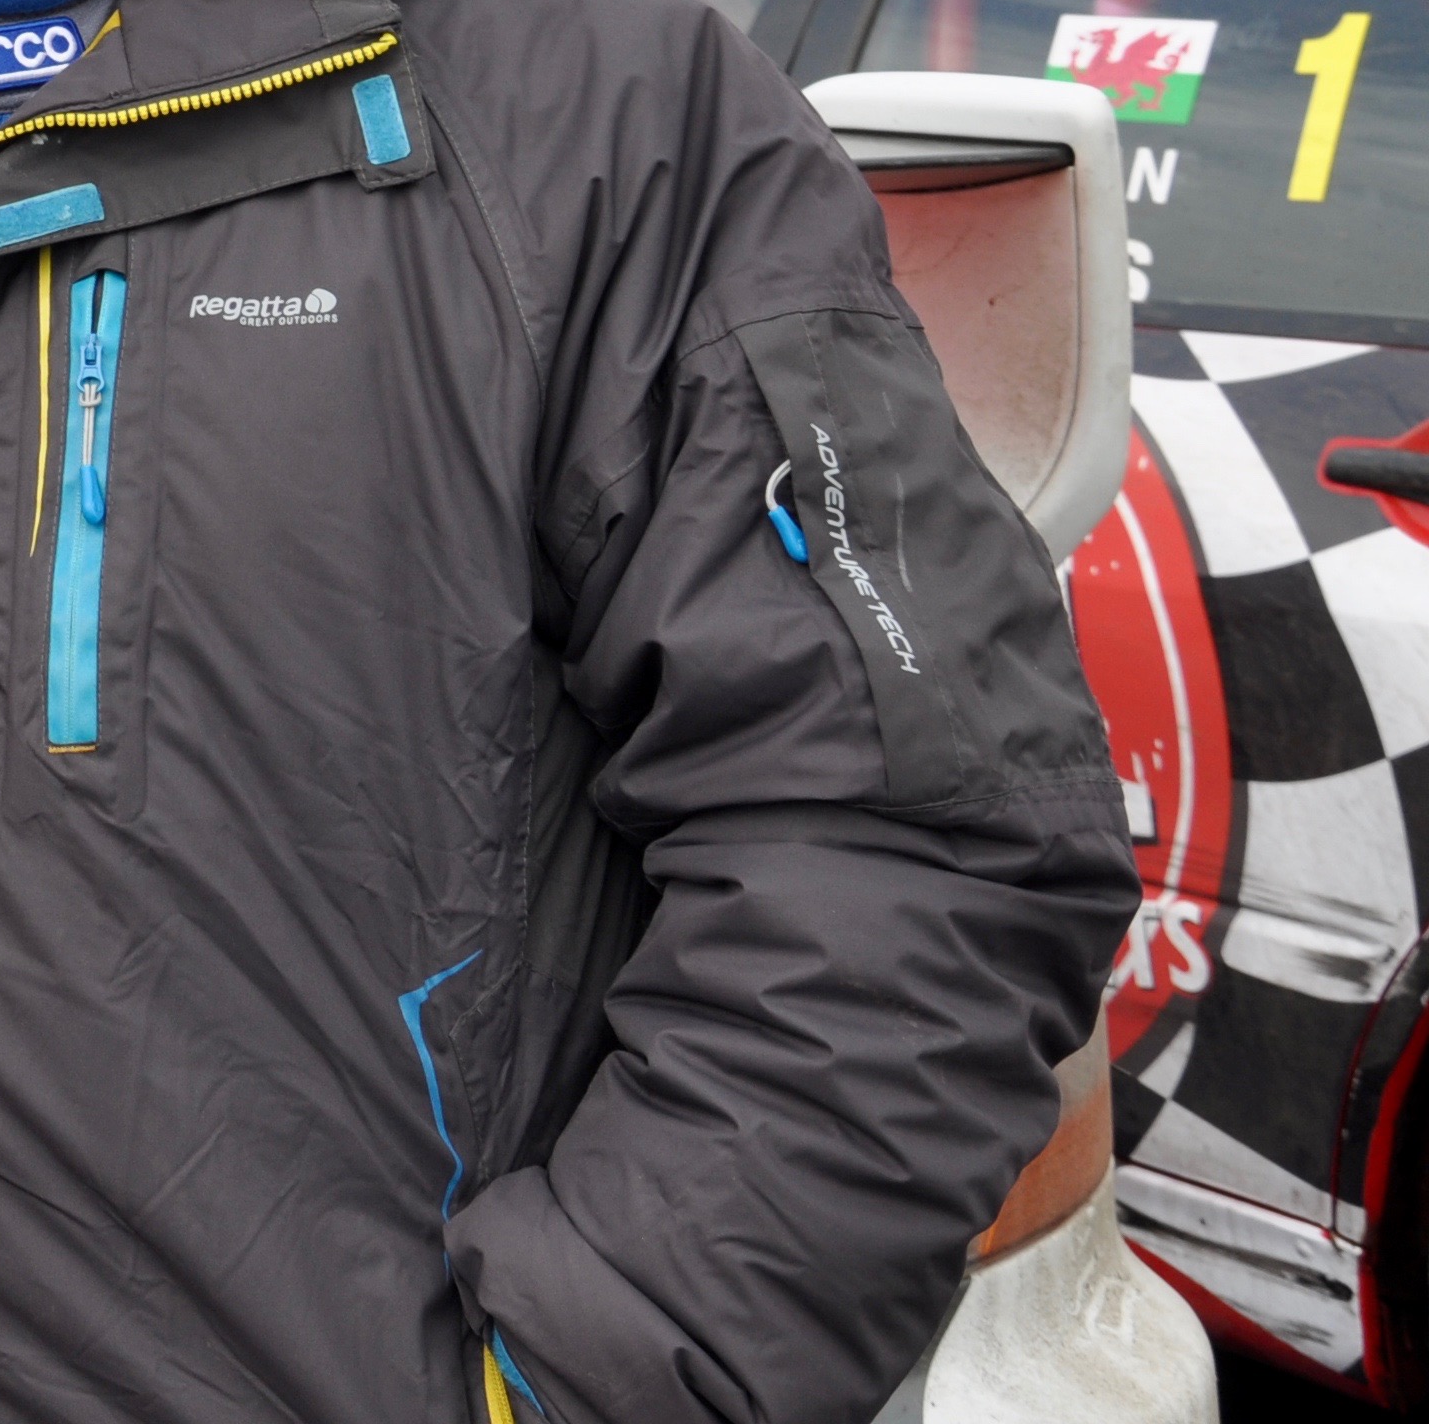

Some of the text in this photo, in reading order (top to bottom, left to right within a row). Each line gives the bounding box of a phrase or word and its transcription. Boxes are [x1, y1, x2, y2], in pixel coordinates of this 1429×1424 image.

[1287, 12, 1372, 203] 1
[189, 294, 303, 321] Regatta
[239, 313, 339, 327] GREAT OUTDOORS
[810, 423, 921, 675] ADVENTURE TECH
